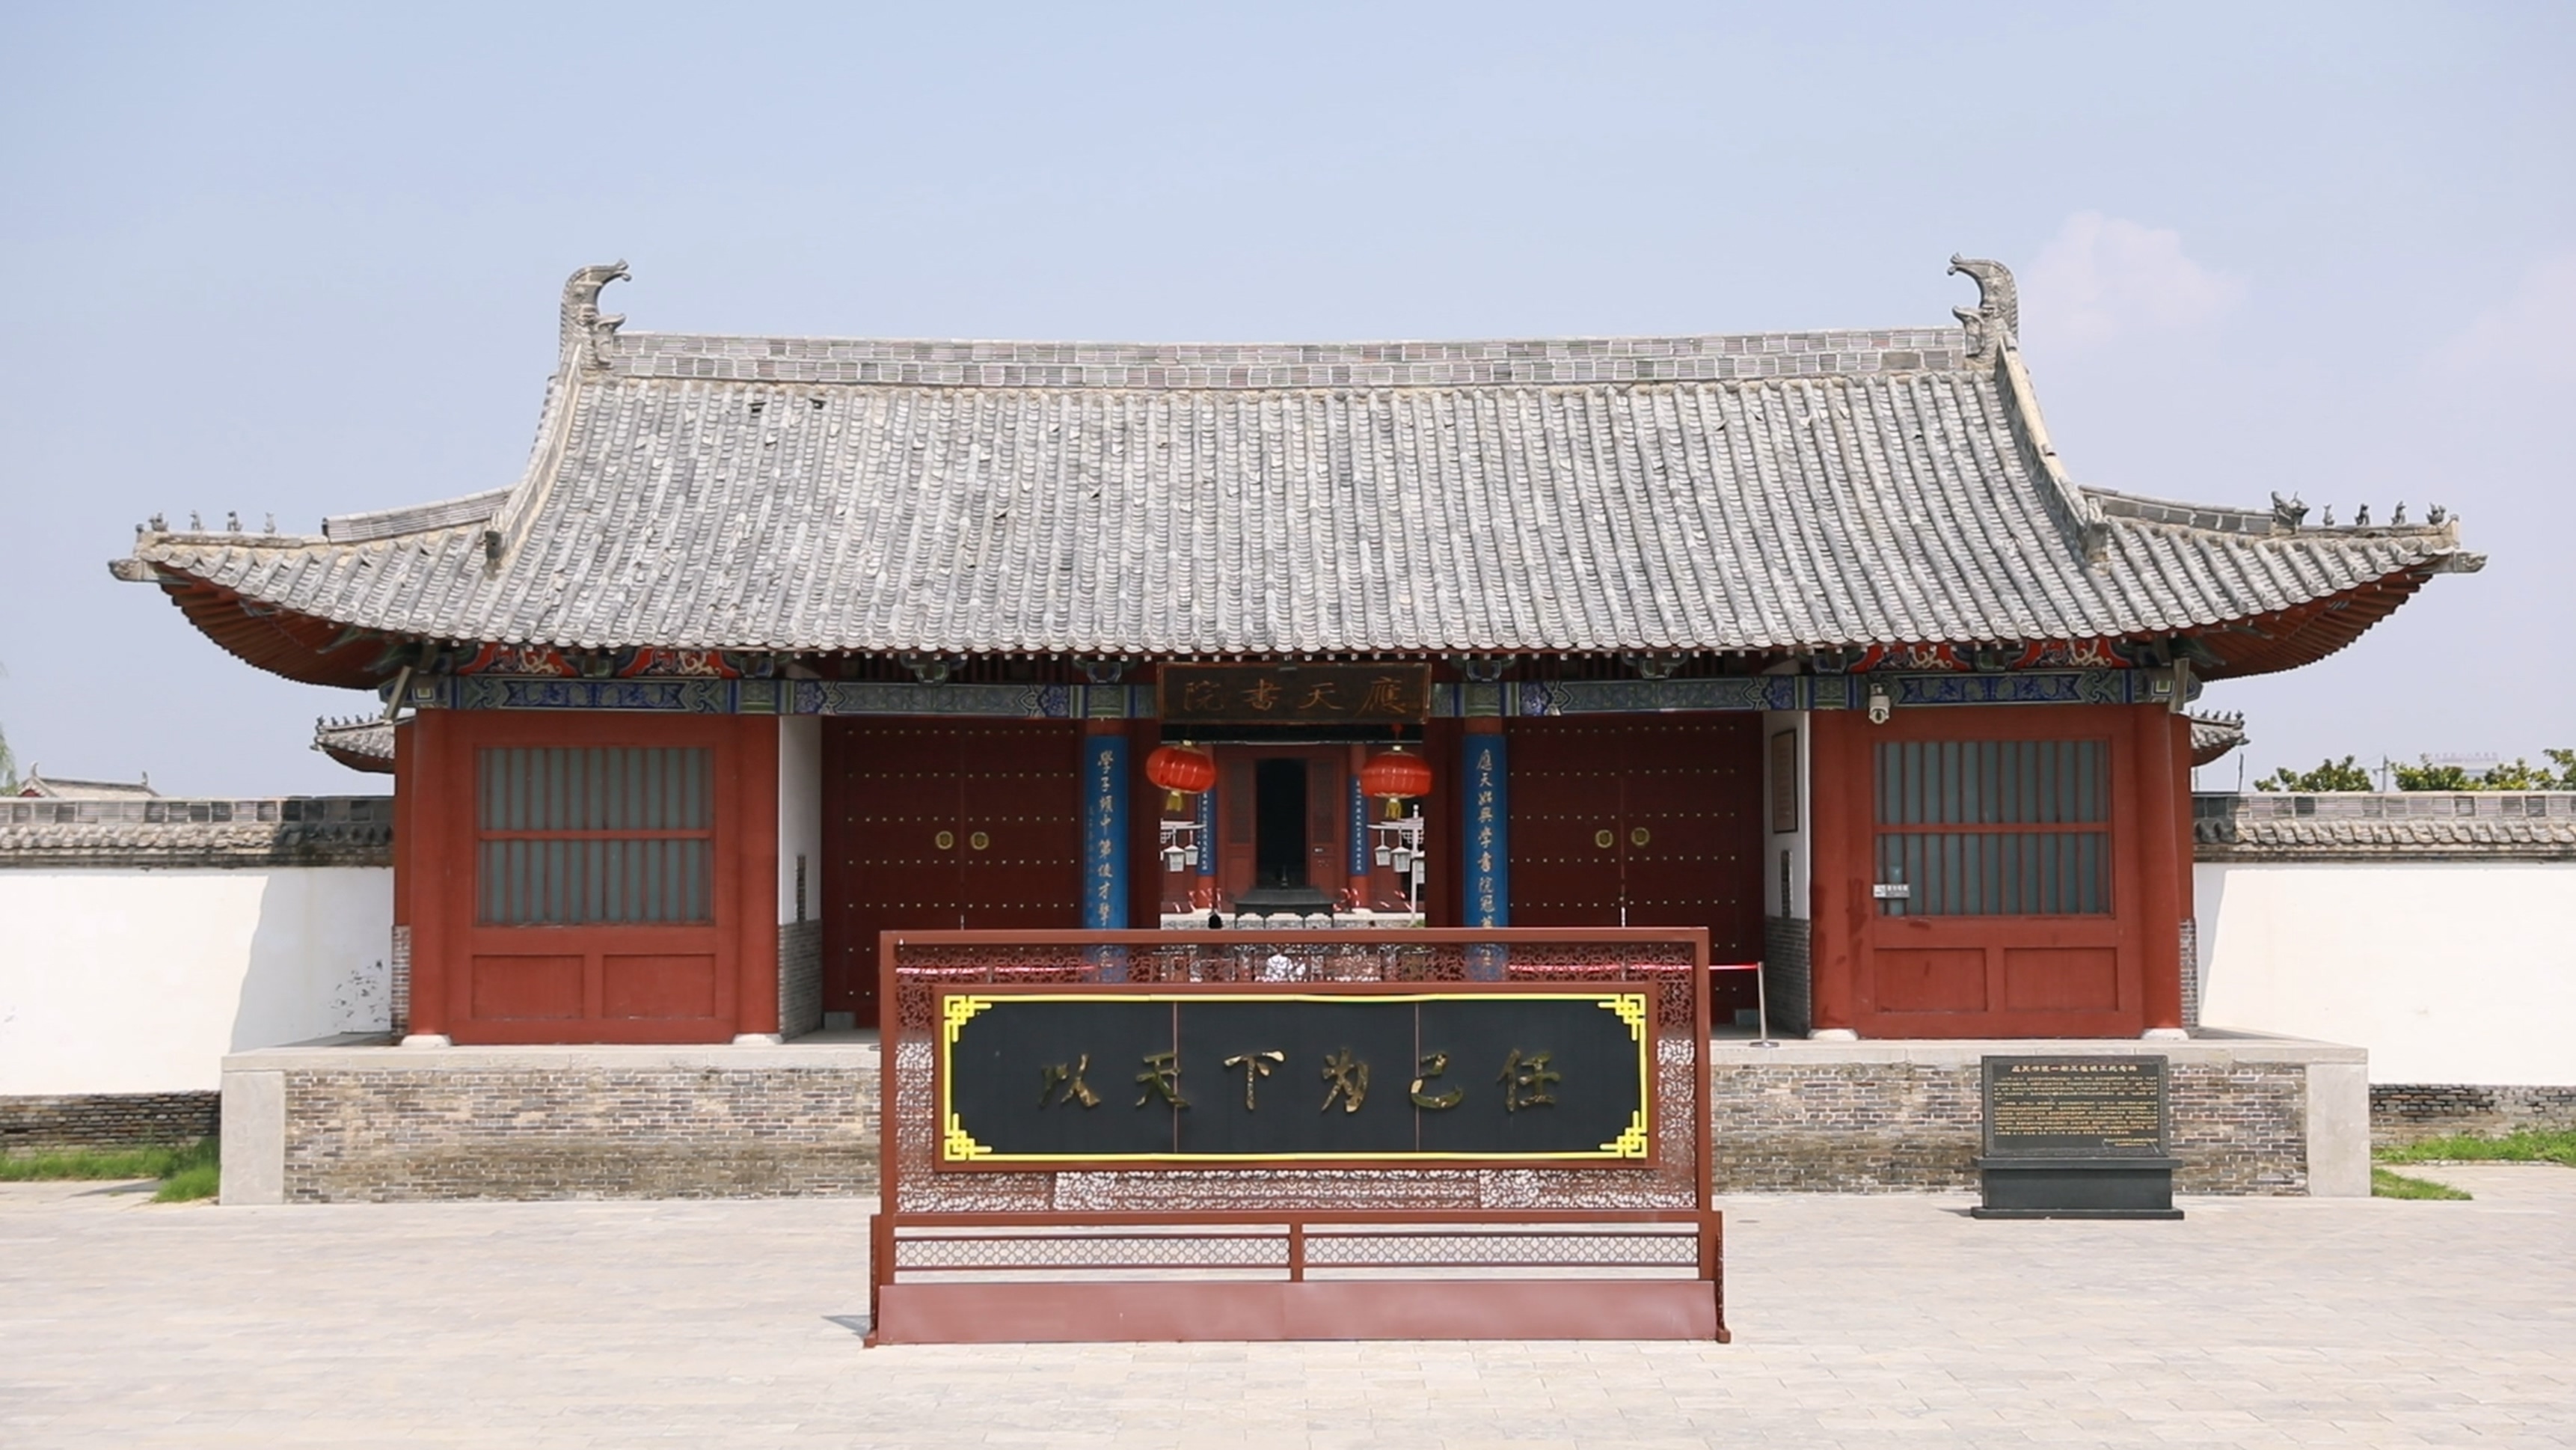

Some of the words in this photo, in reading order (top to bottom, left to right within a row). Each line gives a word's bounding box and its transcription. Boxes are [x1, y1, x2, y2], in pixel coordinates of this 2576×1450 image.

[1039, 1047, 1562, 1113] 以天下为己任
